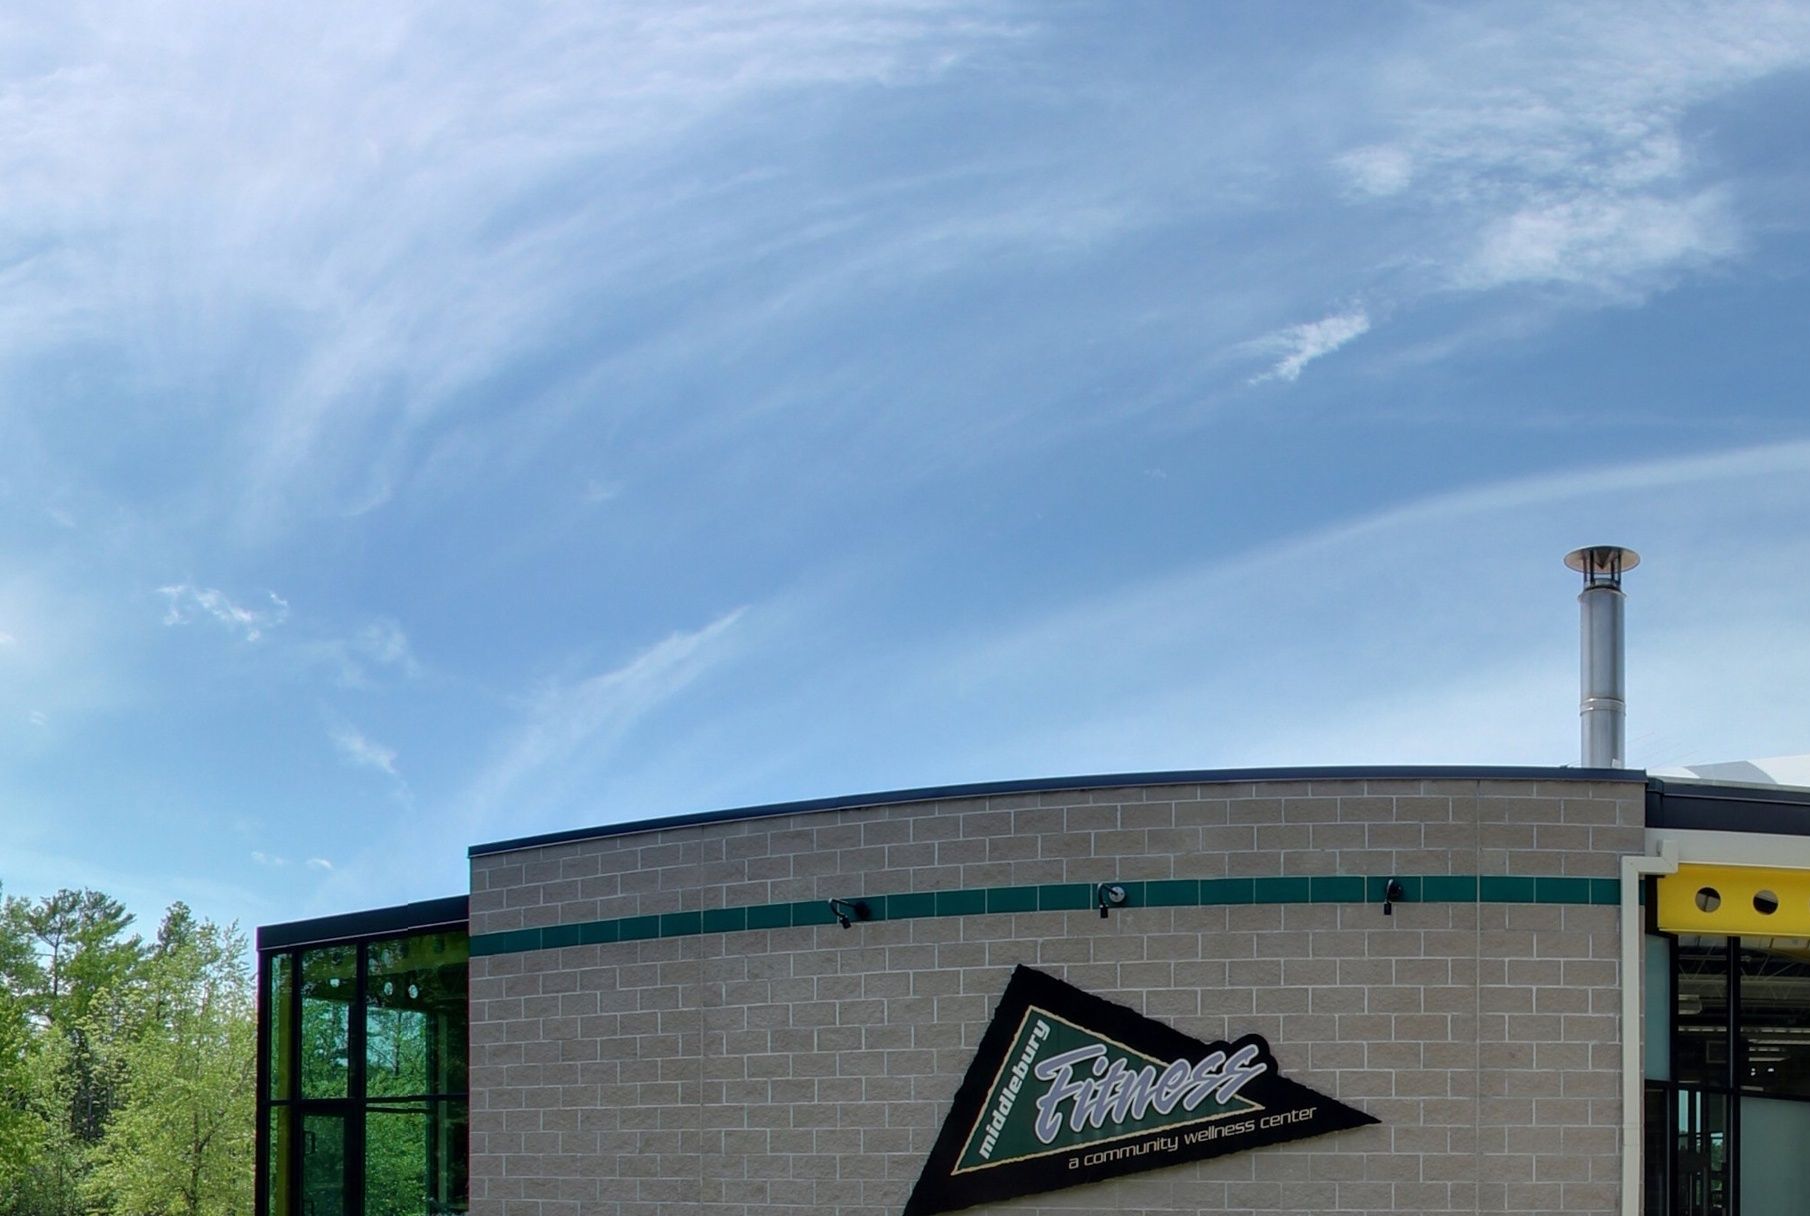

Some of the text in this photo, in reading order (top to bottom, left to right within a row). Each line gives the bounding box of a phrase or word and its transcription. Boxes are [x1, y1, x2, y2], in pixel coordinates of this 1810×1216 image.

[979, 1019, 1050, 1159] middlebury
[1034, 1044, 1266, 1145] Fitness
[1068, 1106, 1317, 1170] a community wellness center
